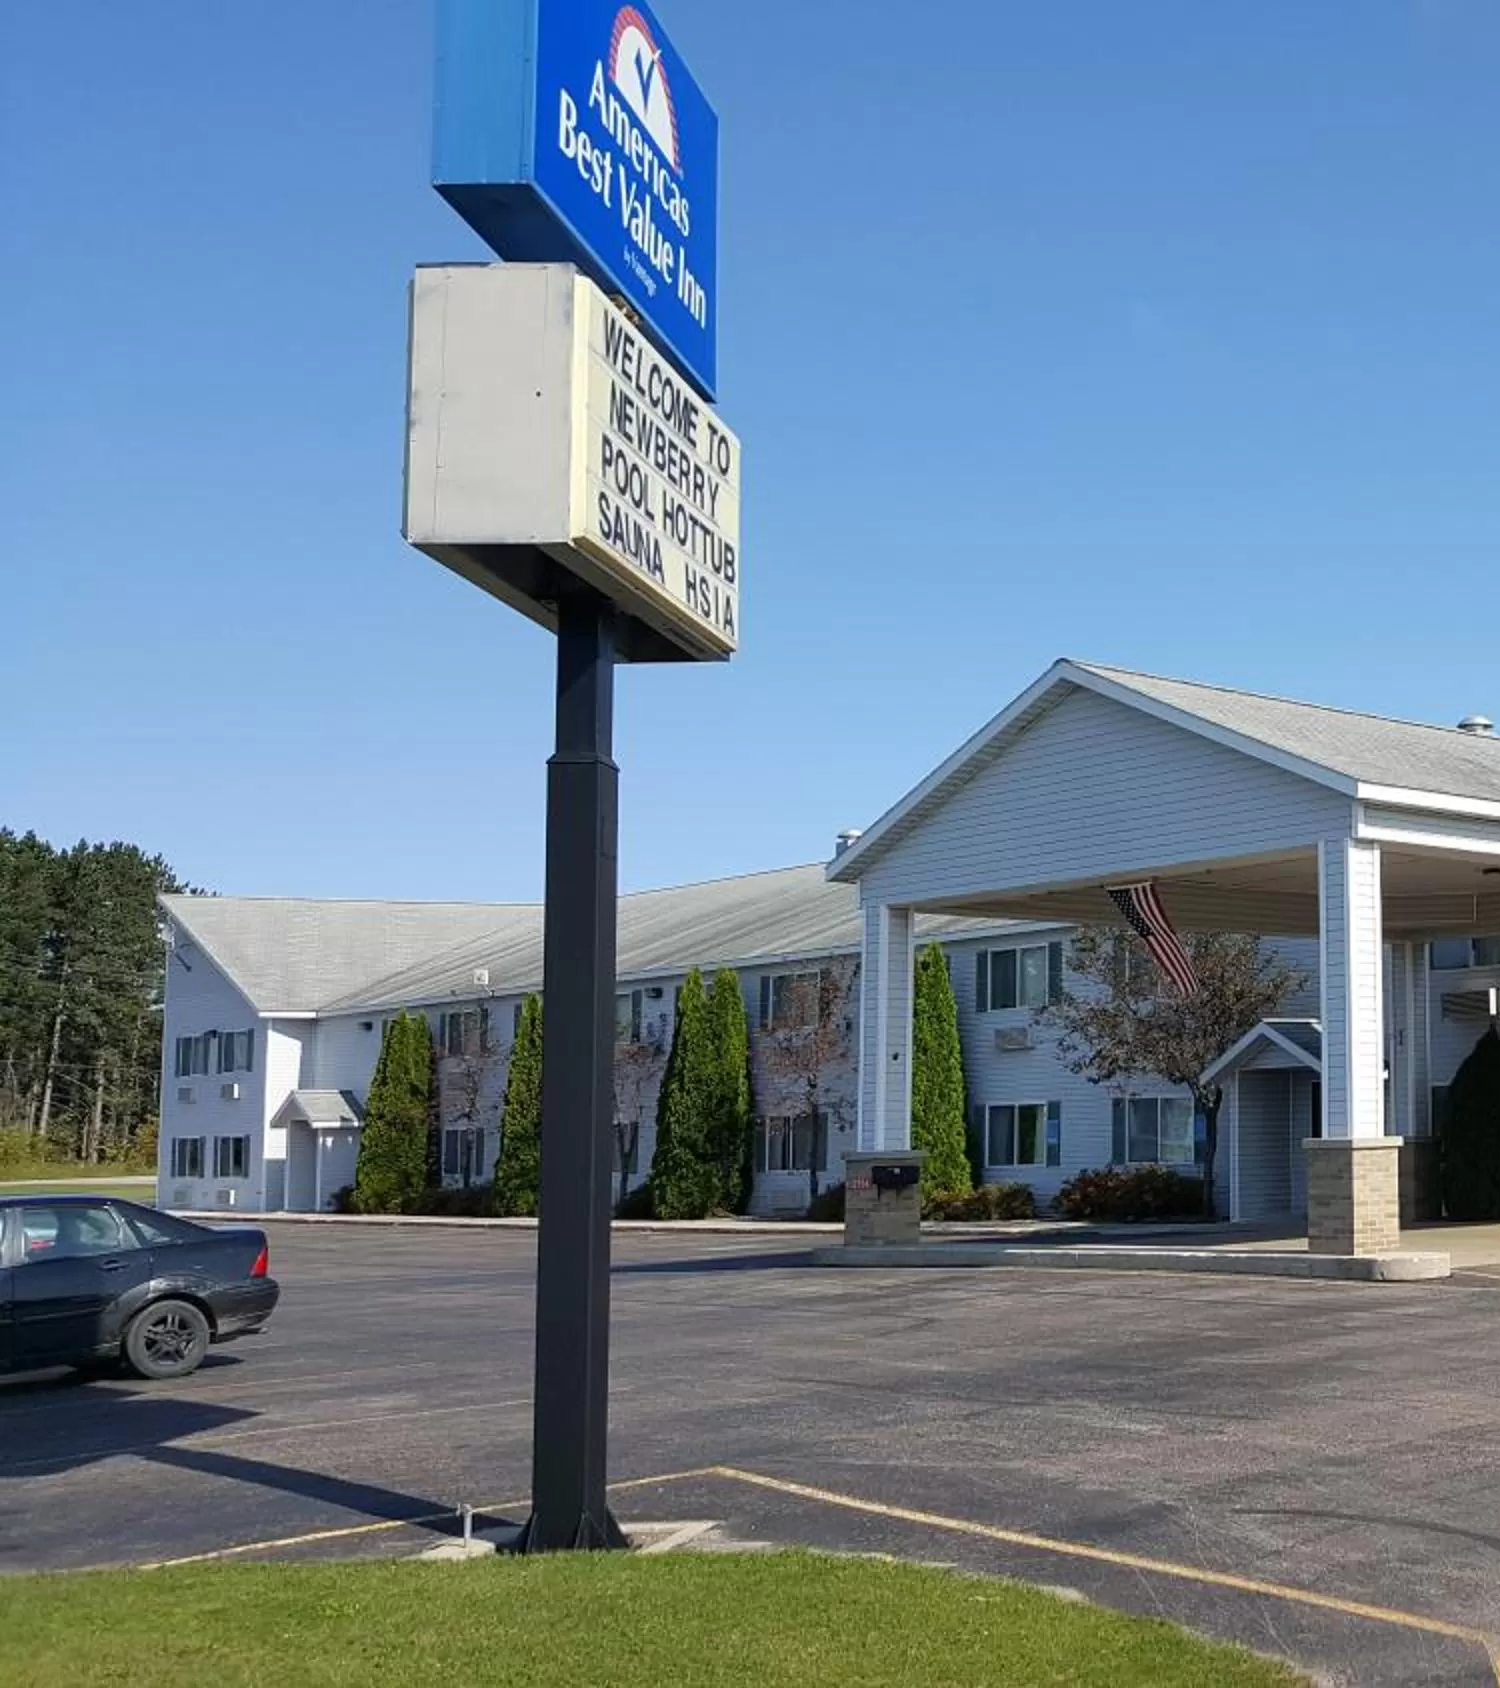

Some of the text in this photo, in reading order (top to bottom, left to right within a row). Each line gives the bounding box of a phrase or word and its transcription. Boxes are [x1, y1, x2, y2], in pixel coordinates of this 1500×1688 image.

[559, 88, 612, 208] Best
[619, 163, 674, 284] Value
[677, 246, 706, 329] Inn
[588, 59, 689, 237] Americas
[603, 307, 731, 476] WELCOME TO
[609, 379, 719, 519] NEWBERRY
[598, 491, 735, 637] SAUNA HSIA
[602, 433, 736, 584] POOL HOTTUB
